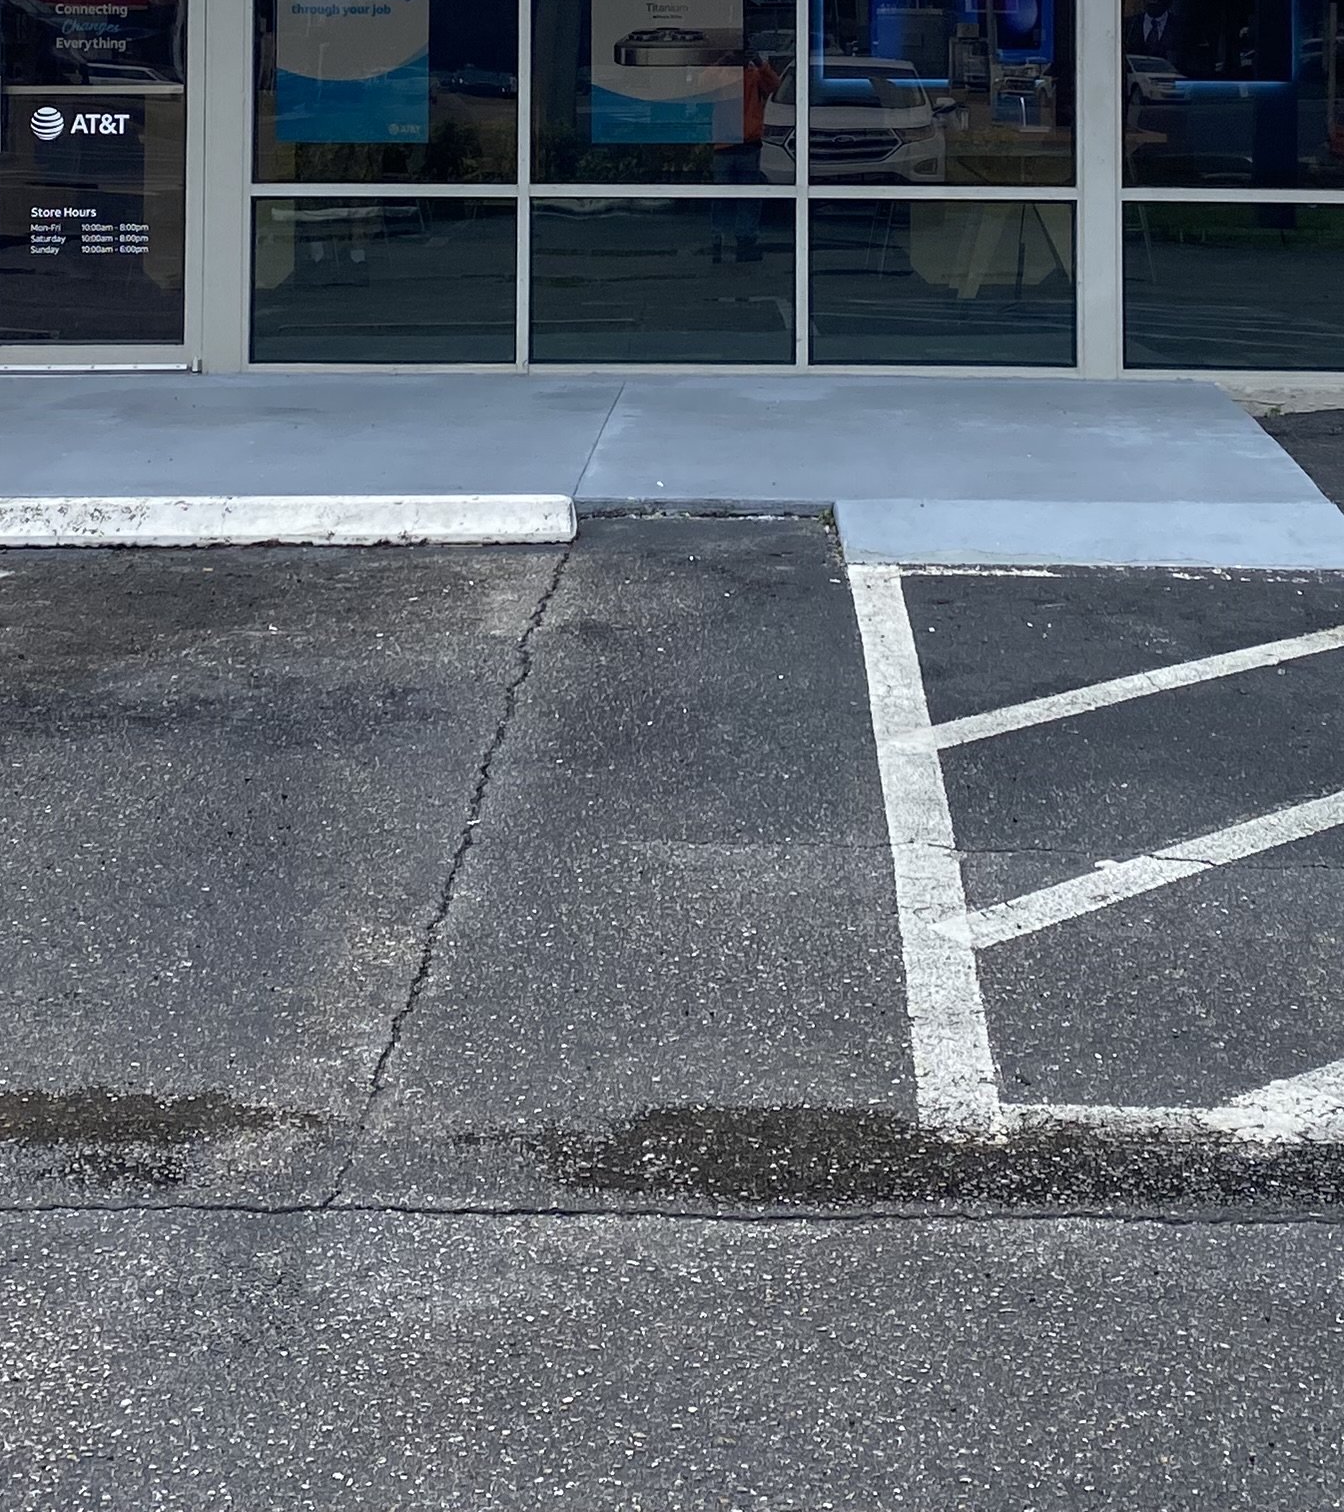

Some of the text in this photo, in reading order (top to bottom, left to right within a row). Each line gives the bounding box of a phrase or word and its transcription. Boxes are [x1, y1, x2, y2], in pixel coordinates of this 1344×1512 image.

[55, 3, 128, 18] Connecting
[291, 4, 392, 17] through your job
[61, 19, 121, 36] Changes
[70, 113, 130, 134] AT&T
[31, 207, 97, 217] Store Hours
[30, 224, 61, 232] Mon-Fri
[119, 224, 149, 233] 8:00pm
[30, 235, 66, 244] Saturday
[119, 235, 149, 244] 8:00pm
[30, 246, 60, 255] Sunday
